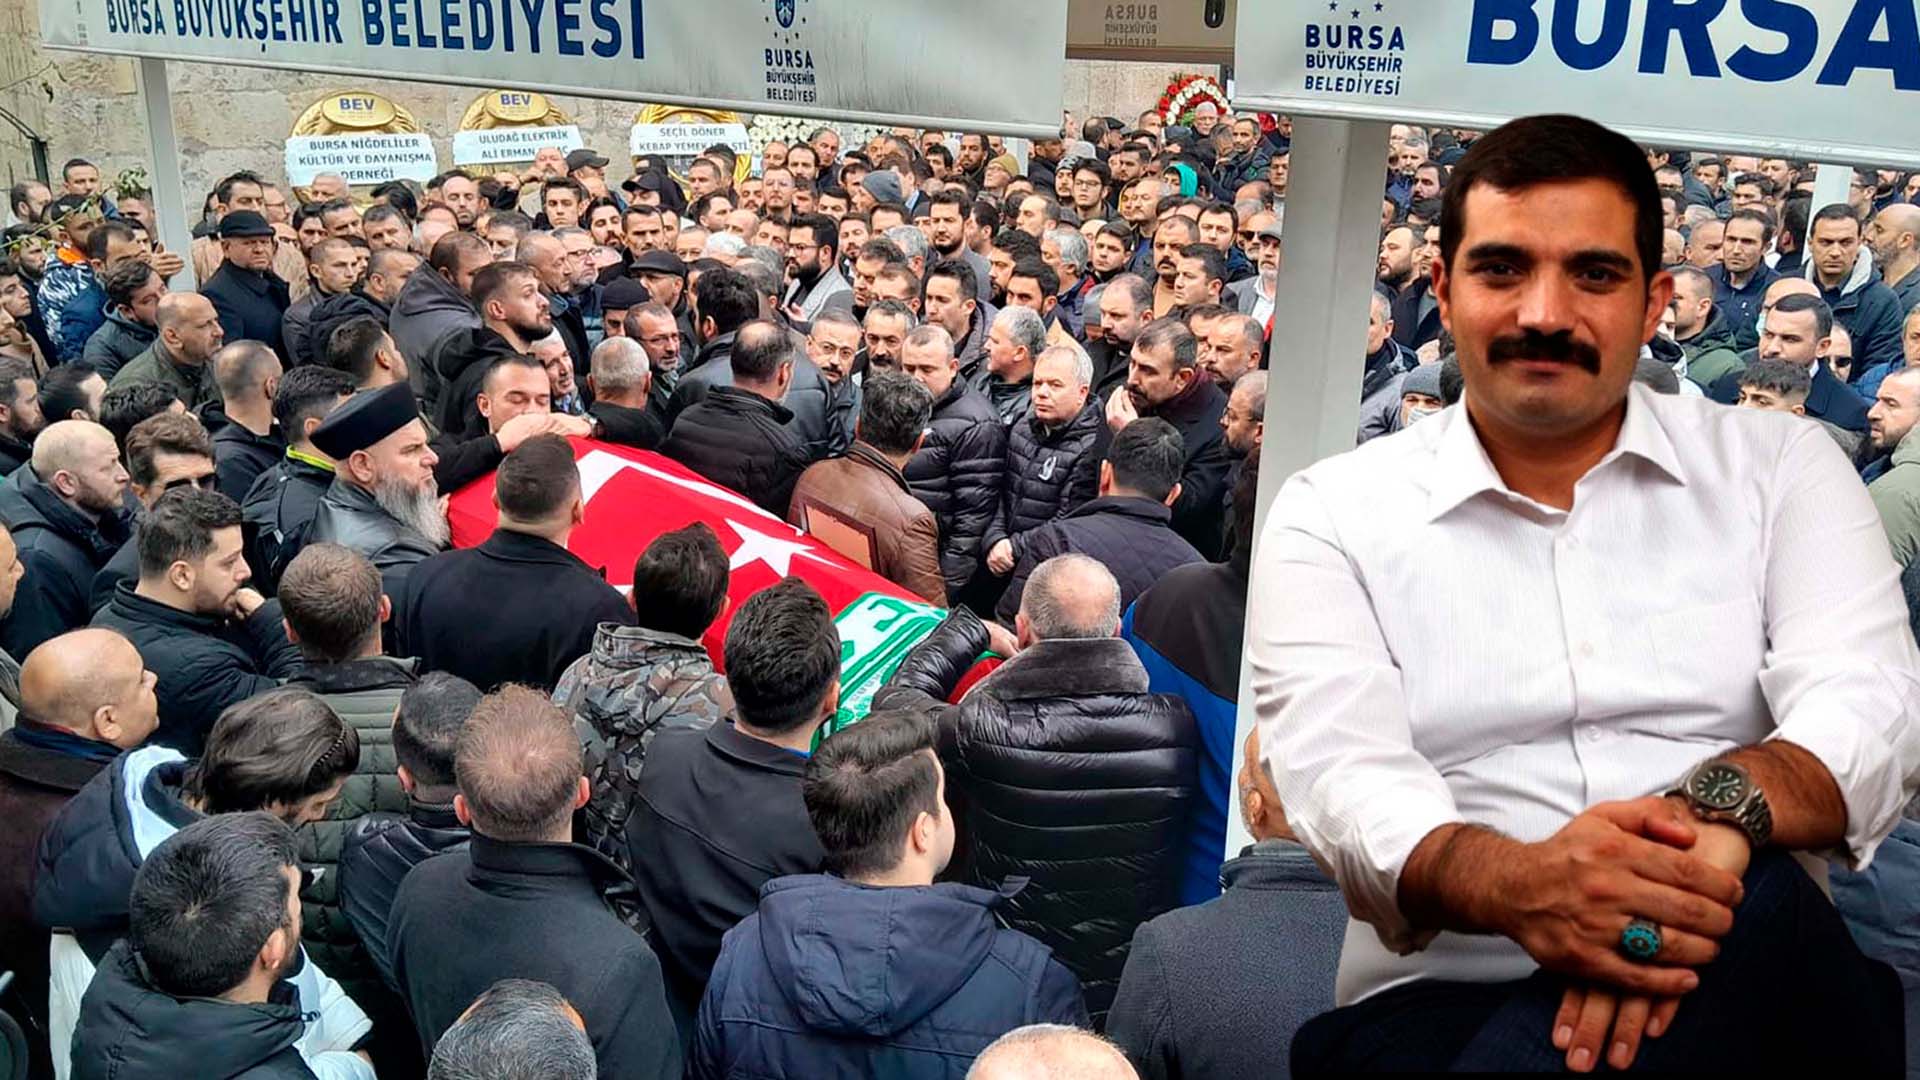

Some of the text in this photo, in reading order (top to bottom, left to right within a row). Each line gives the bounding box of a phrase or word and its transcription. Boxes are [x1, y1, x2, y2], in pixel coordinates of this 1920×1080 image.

[106, 0, 166, 35] BURSA
[1305, 24, 1405, 51] BURSA
[765, 48, 814, 69] BURSA
[1305, 72, 1401, 96] BELEDİYESİ
[339, 98, 375, 111] BEV
[500, 94, 532, 106] BEV
[479, 131, 520, 144] ULUDAĞ
[310, 140, 348, 151] BURSA
[501, 146, 535, 158] ERMAN
[639, 141, 672, 151] KEBAP
[299, 152, 433, 166] KÜLTÜR VE DAYANIŞMA
